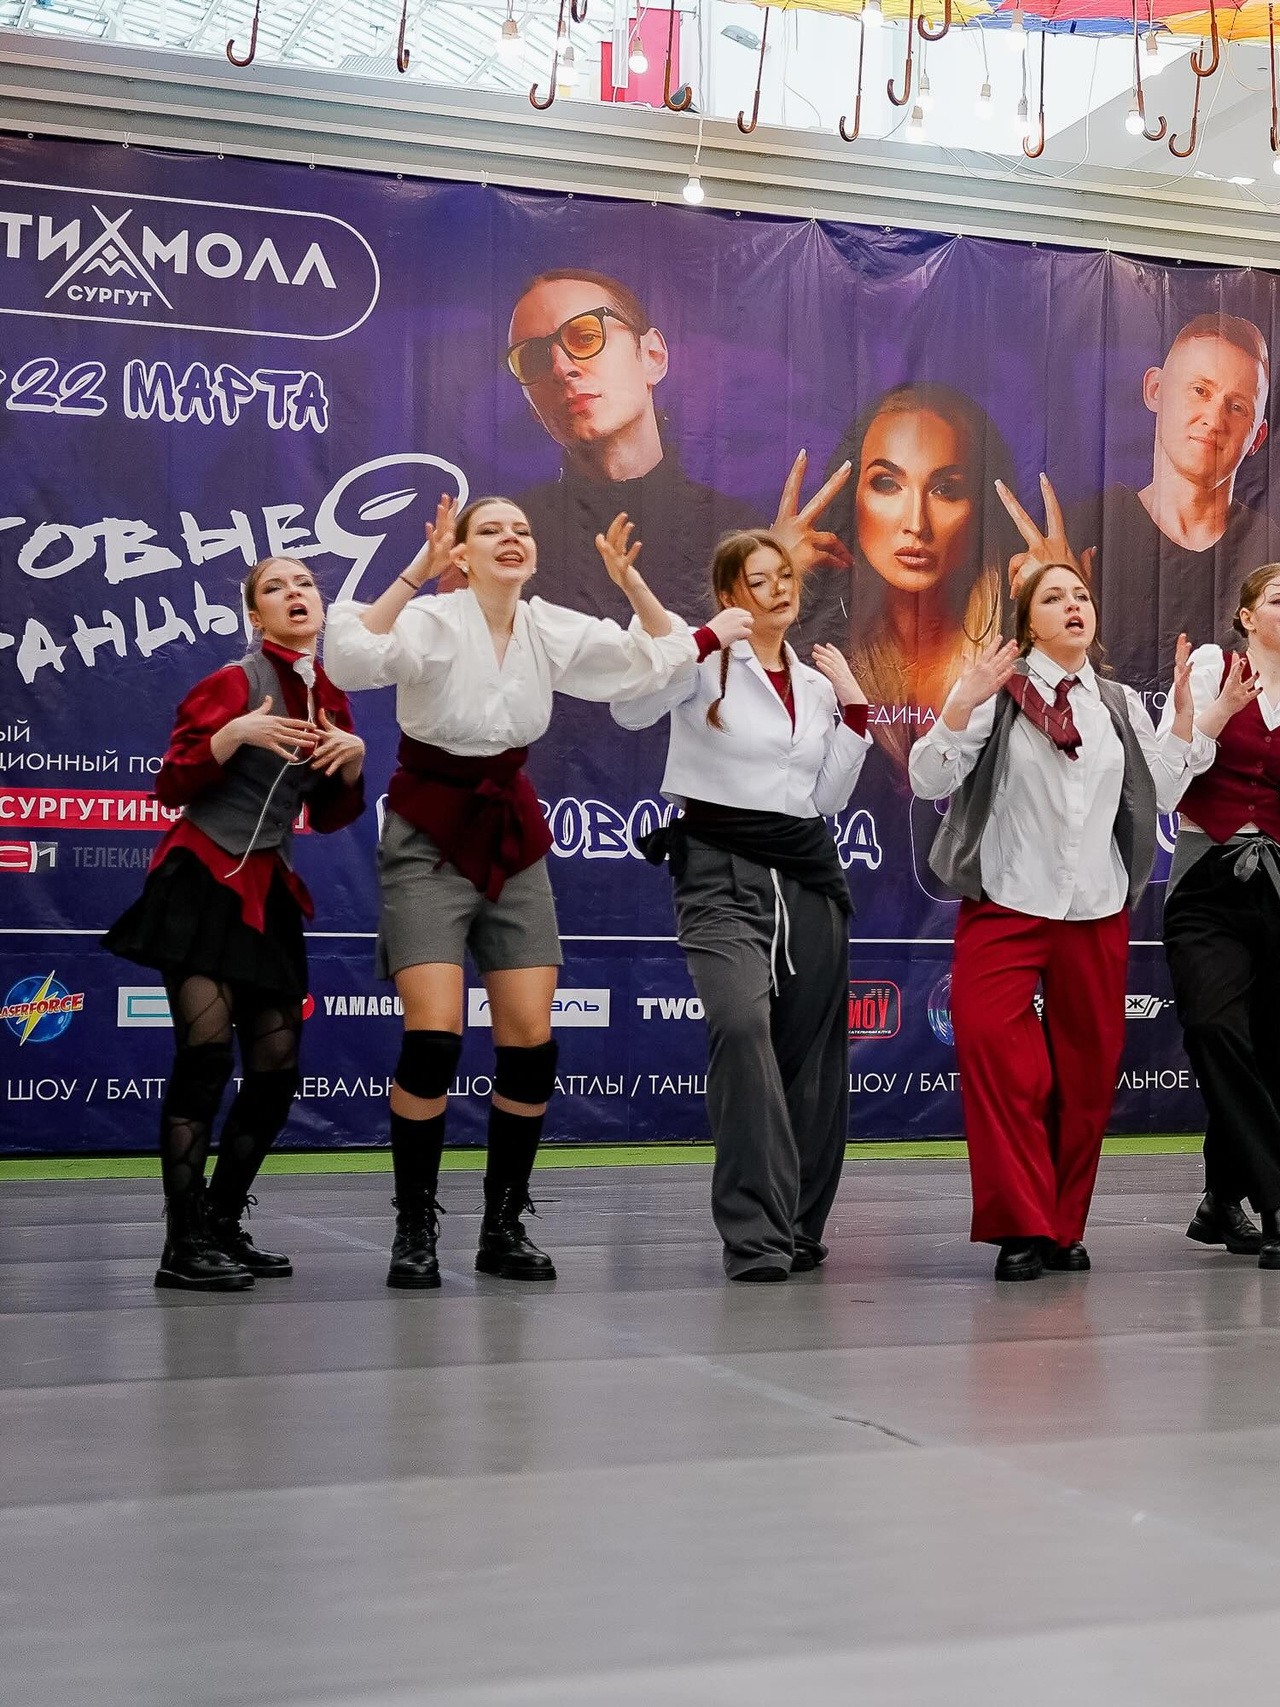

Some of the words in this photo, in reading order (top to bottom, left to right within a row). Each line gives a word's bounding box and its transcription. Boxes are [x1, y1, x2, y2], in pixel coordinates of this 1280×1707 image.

[67, 285, 152, 307] СУРГУТ
[123, 358, 328, 433] МАРТА
[0, 504, 330, 584] ОВЫЕ
[0, 581, 253, 684] АНЦЫ
[0, 795, 185, 822] СУРГУТИНФ
[73, 847, 153, 869] ТЕЛЕКАН
[0, 993, 85, 1019] ASERFORCE
[323, 996, 404, 1016] YAMAGU
[7, 1078, 77, 1100] ШОУ
[107, 1078, 166, 1100] БАТТ
[554, 1074, 624, 1095] АТТЛЫ
[648, 1074, 708, 1095] ТАНЦ
[1114, 1070, 1189, 1089] ЛЬНОЕ
